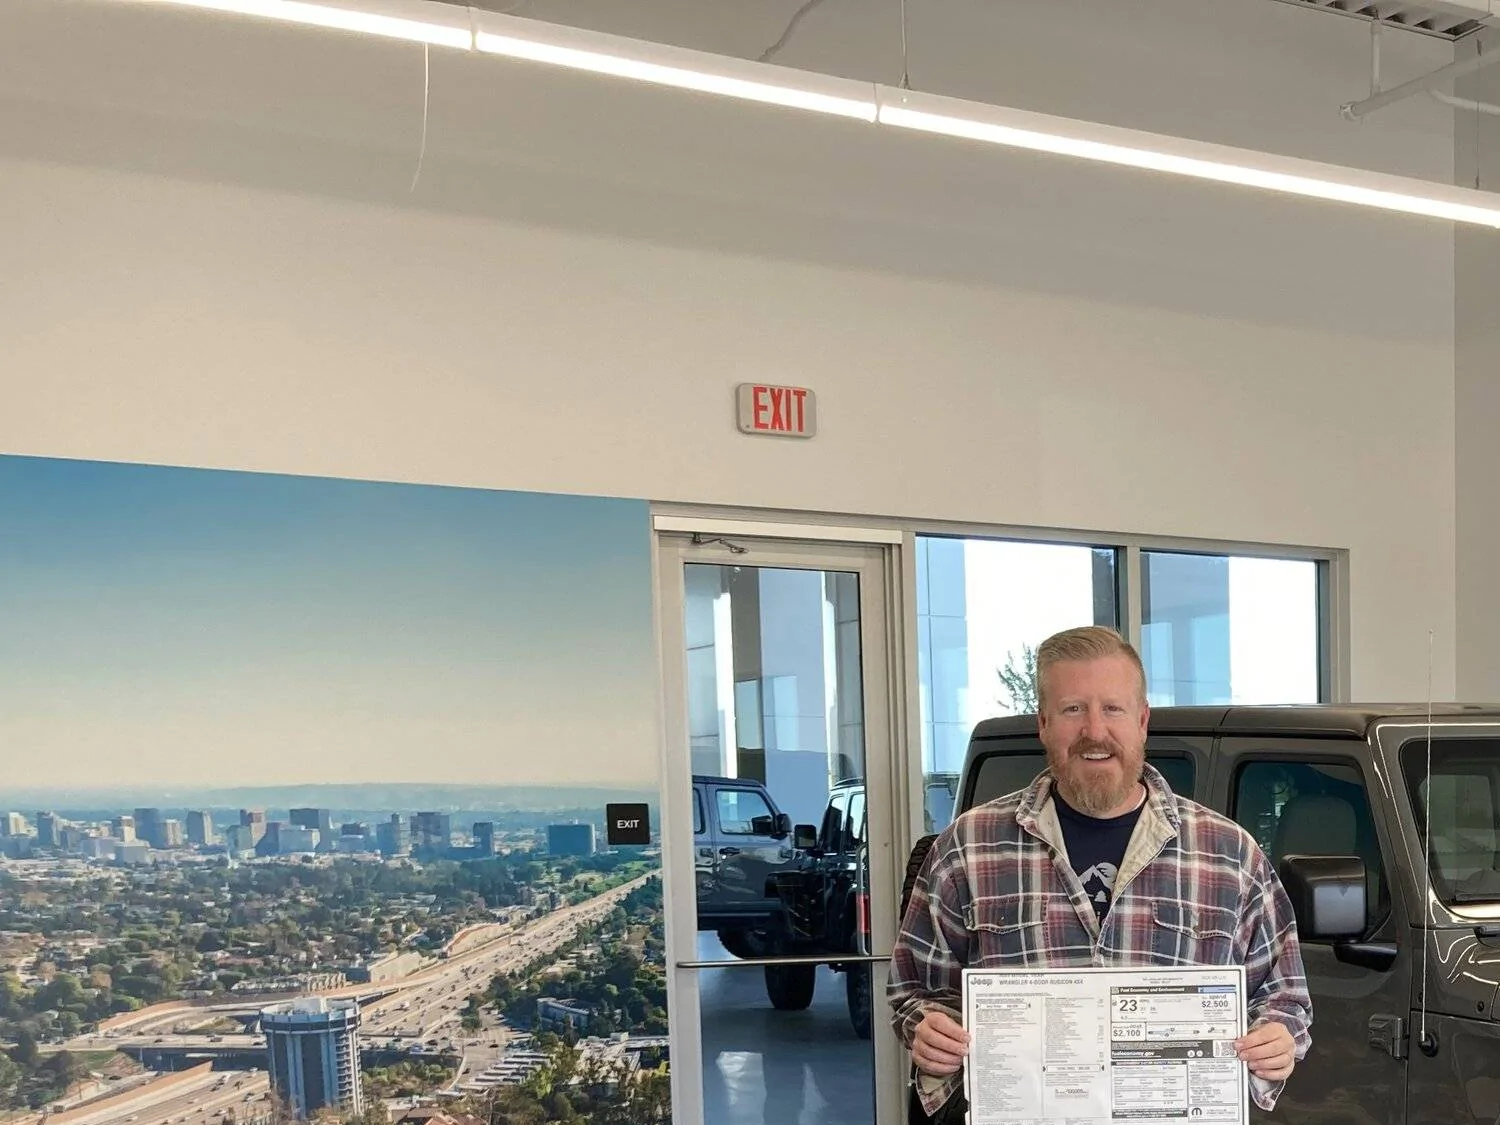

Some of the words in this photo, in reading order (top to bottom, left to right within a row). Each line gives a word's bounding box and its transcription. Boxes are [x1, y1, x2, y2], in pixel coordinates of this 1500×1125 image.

[752, 386, 807, 432] EXIT
[616, 819, 640, 829] EXIT
[970, 977, 993, 987] Jeep
[1119, 999, 1138, 1012] 23
